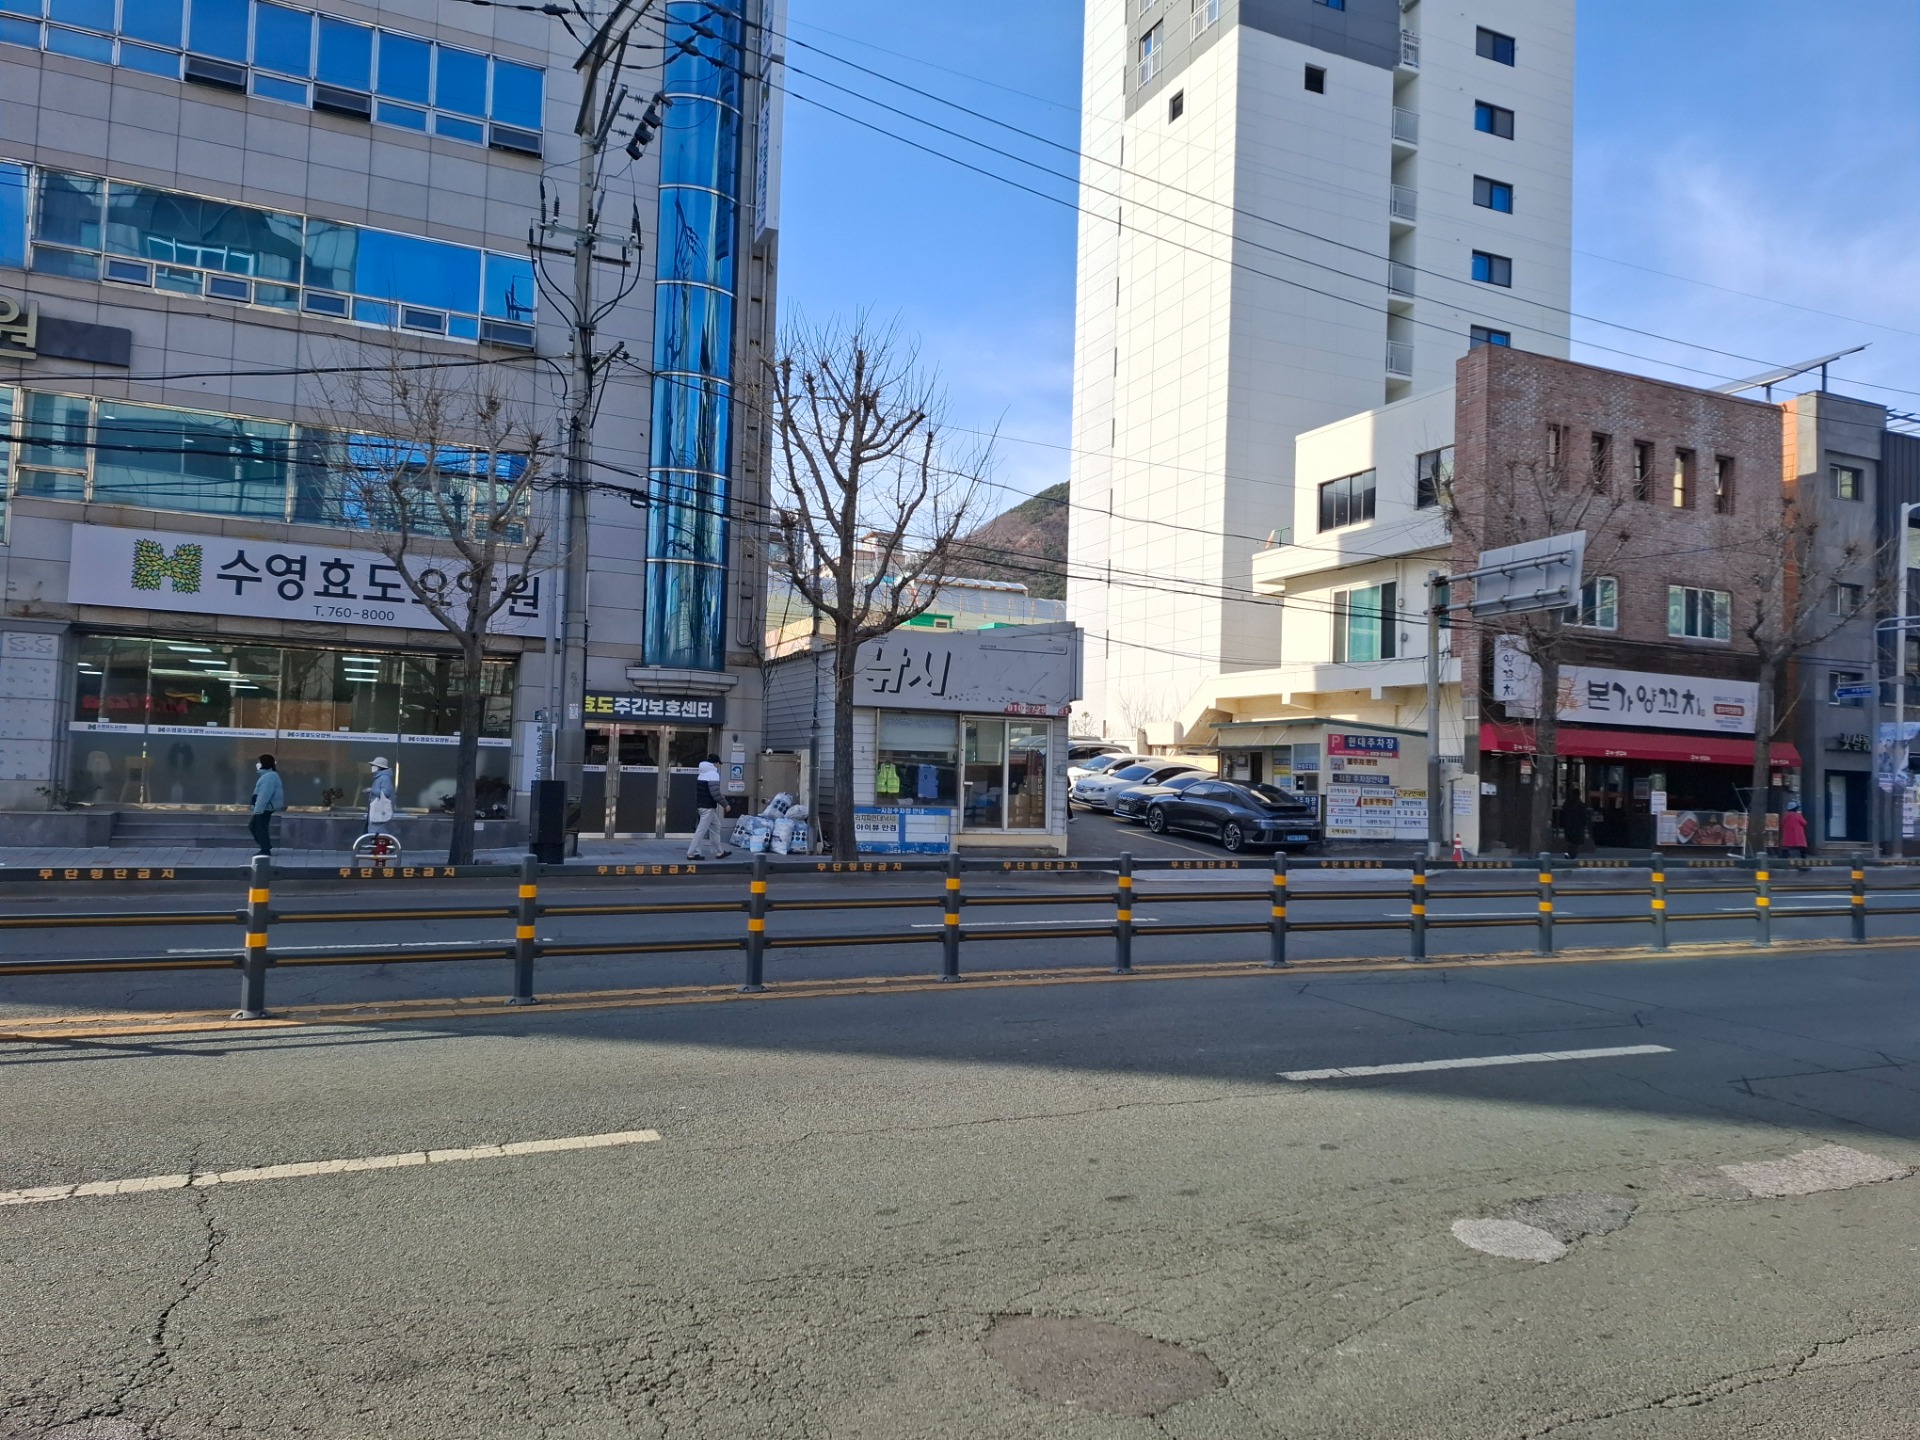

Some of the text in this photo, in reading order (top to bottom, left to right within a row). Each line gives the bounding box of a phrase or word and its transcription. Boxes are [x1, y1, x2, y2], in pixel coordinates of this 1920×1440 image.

[313, 605, 395, 622] T. 760-8000
[866, 647, 952, 696] 낚시
[1587, 680, 1702, 717] 본가양꼬치
[1331, 735, 1394, 748] P 현대주차장
[856, 824, 879, 832] 아이뷰
[38, 868, 175, 880] 무단횡단금지
[339, 867, 456, 878] 무단횡단금지
[597, 865, 697, 875] 무단횡단금지
